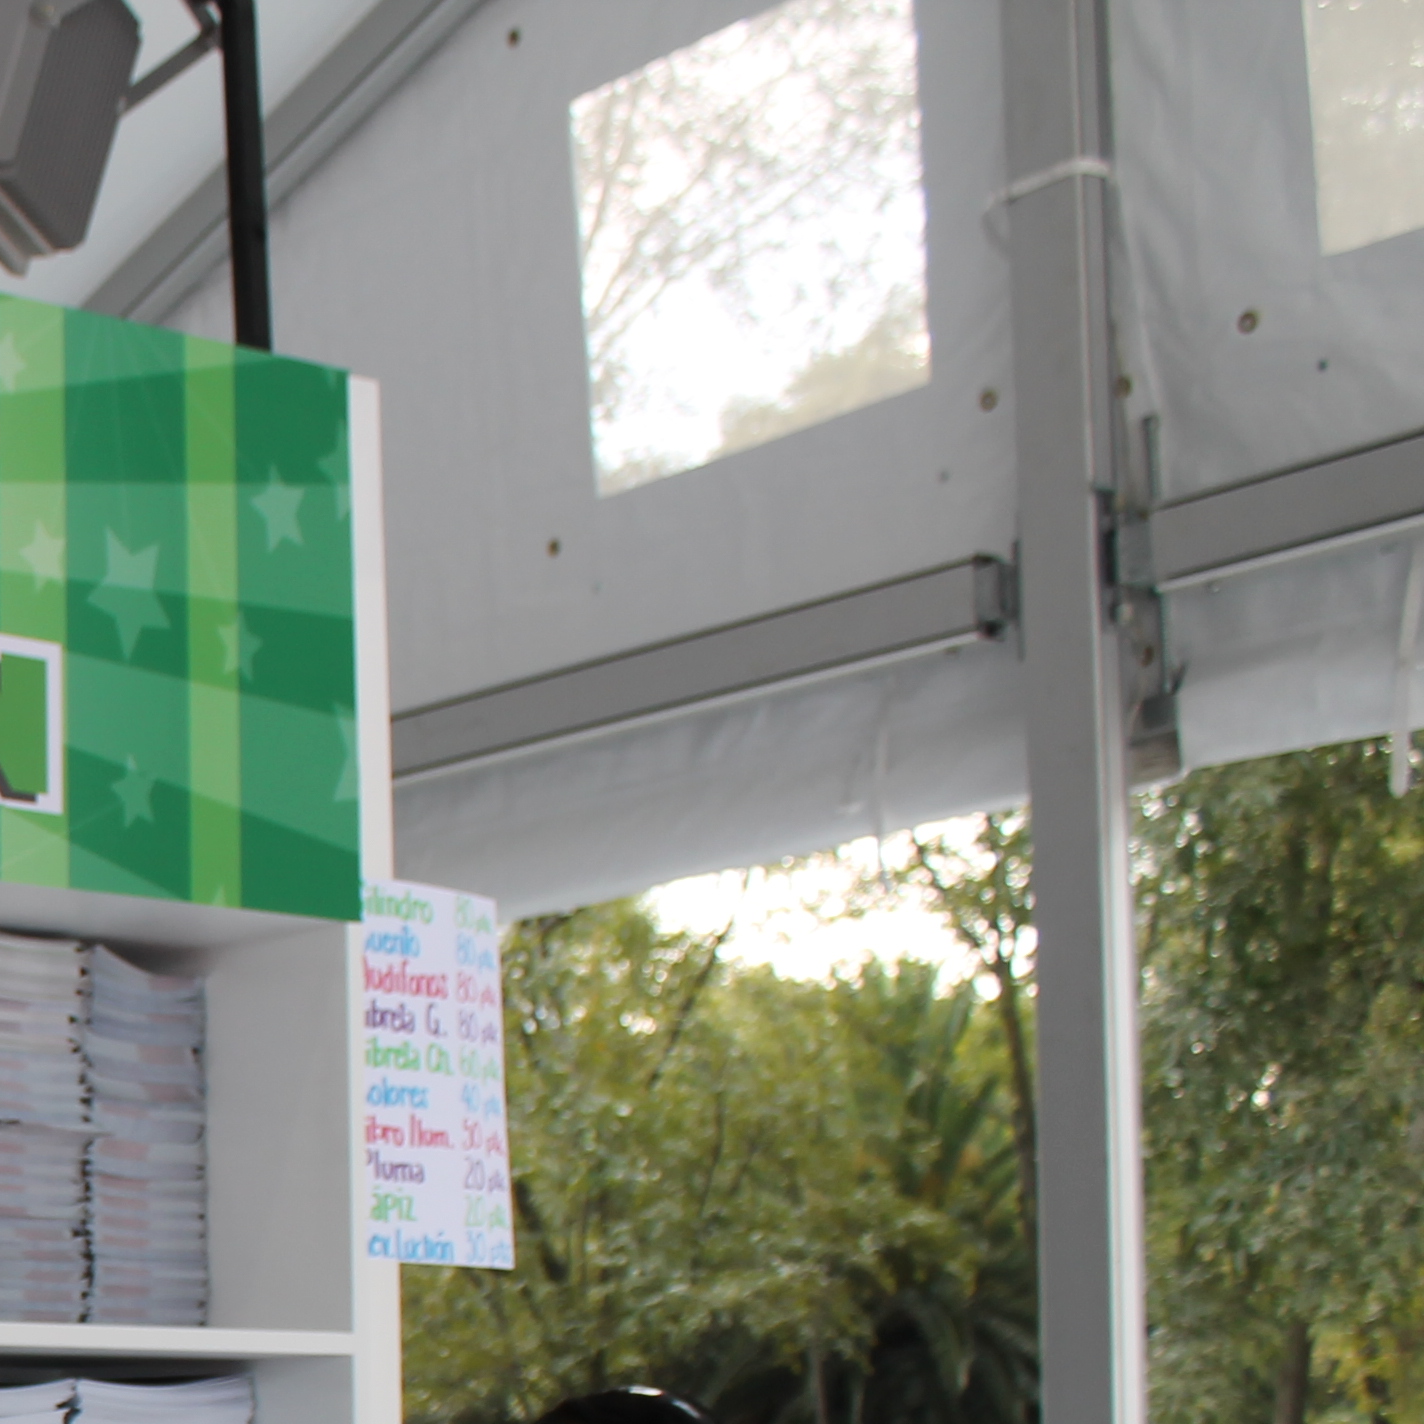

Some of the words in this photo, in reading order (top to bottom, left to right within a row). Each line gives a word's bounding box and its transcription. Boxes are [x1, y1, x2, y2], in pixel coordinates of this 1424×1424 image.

[365, 886, 433, 924] ilindro
[365, 926, 421, 957] uento
[365, 1000, 415, 1033] ibreta
[365, 1036, 420, 1071] ibreta
[367, 1076, 428, 1109] olores
[365, 1115, 403, 1147] ibro
[369, 1185, 416, 1222] ápiz
